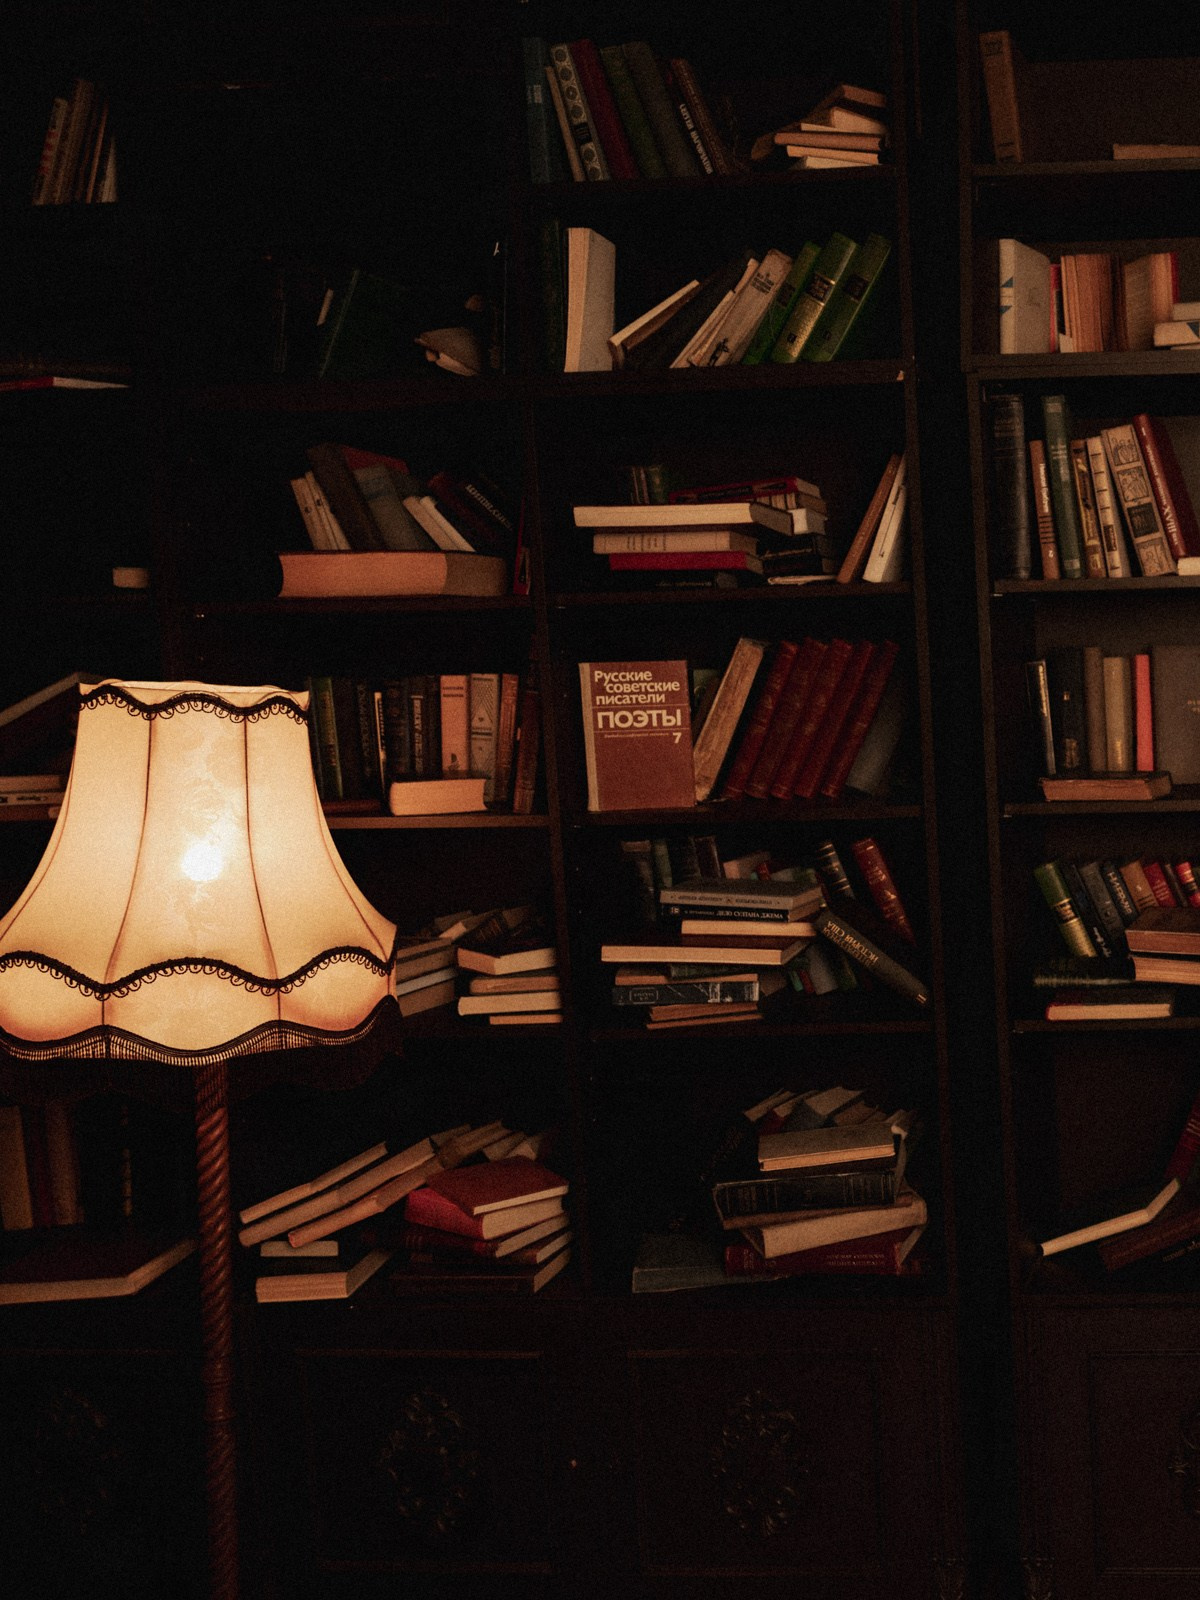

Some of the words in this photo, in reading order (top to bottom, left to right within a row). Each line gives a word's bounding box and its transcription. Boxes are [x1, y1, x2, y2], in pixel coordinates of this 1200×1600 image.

[1161, 505, 1176, 533] XVIII
[594, 670, 652, 686] Русские
[606, 681, 680, 693] советские
[596, 693, 666, 705] писатели
[597, 709, 682, 728] ПОЭТЫ
[673, 732, 682, 743] 7
[733, 910, 759, 918] СУЛТАНА
[825, 919, 845, 938] США
[843, 933, 879, 963] ИСТОРИЯ
